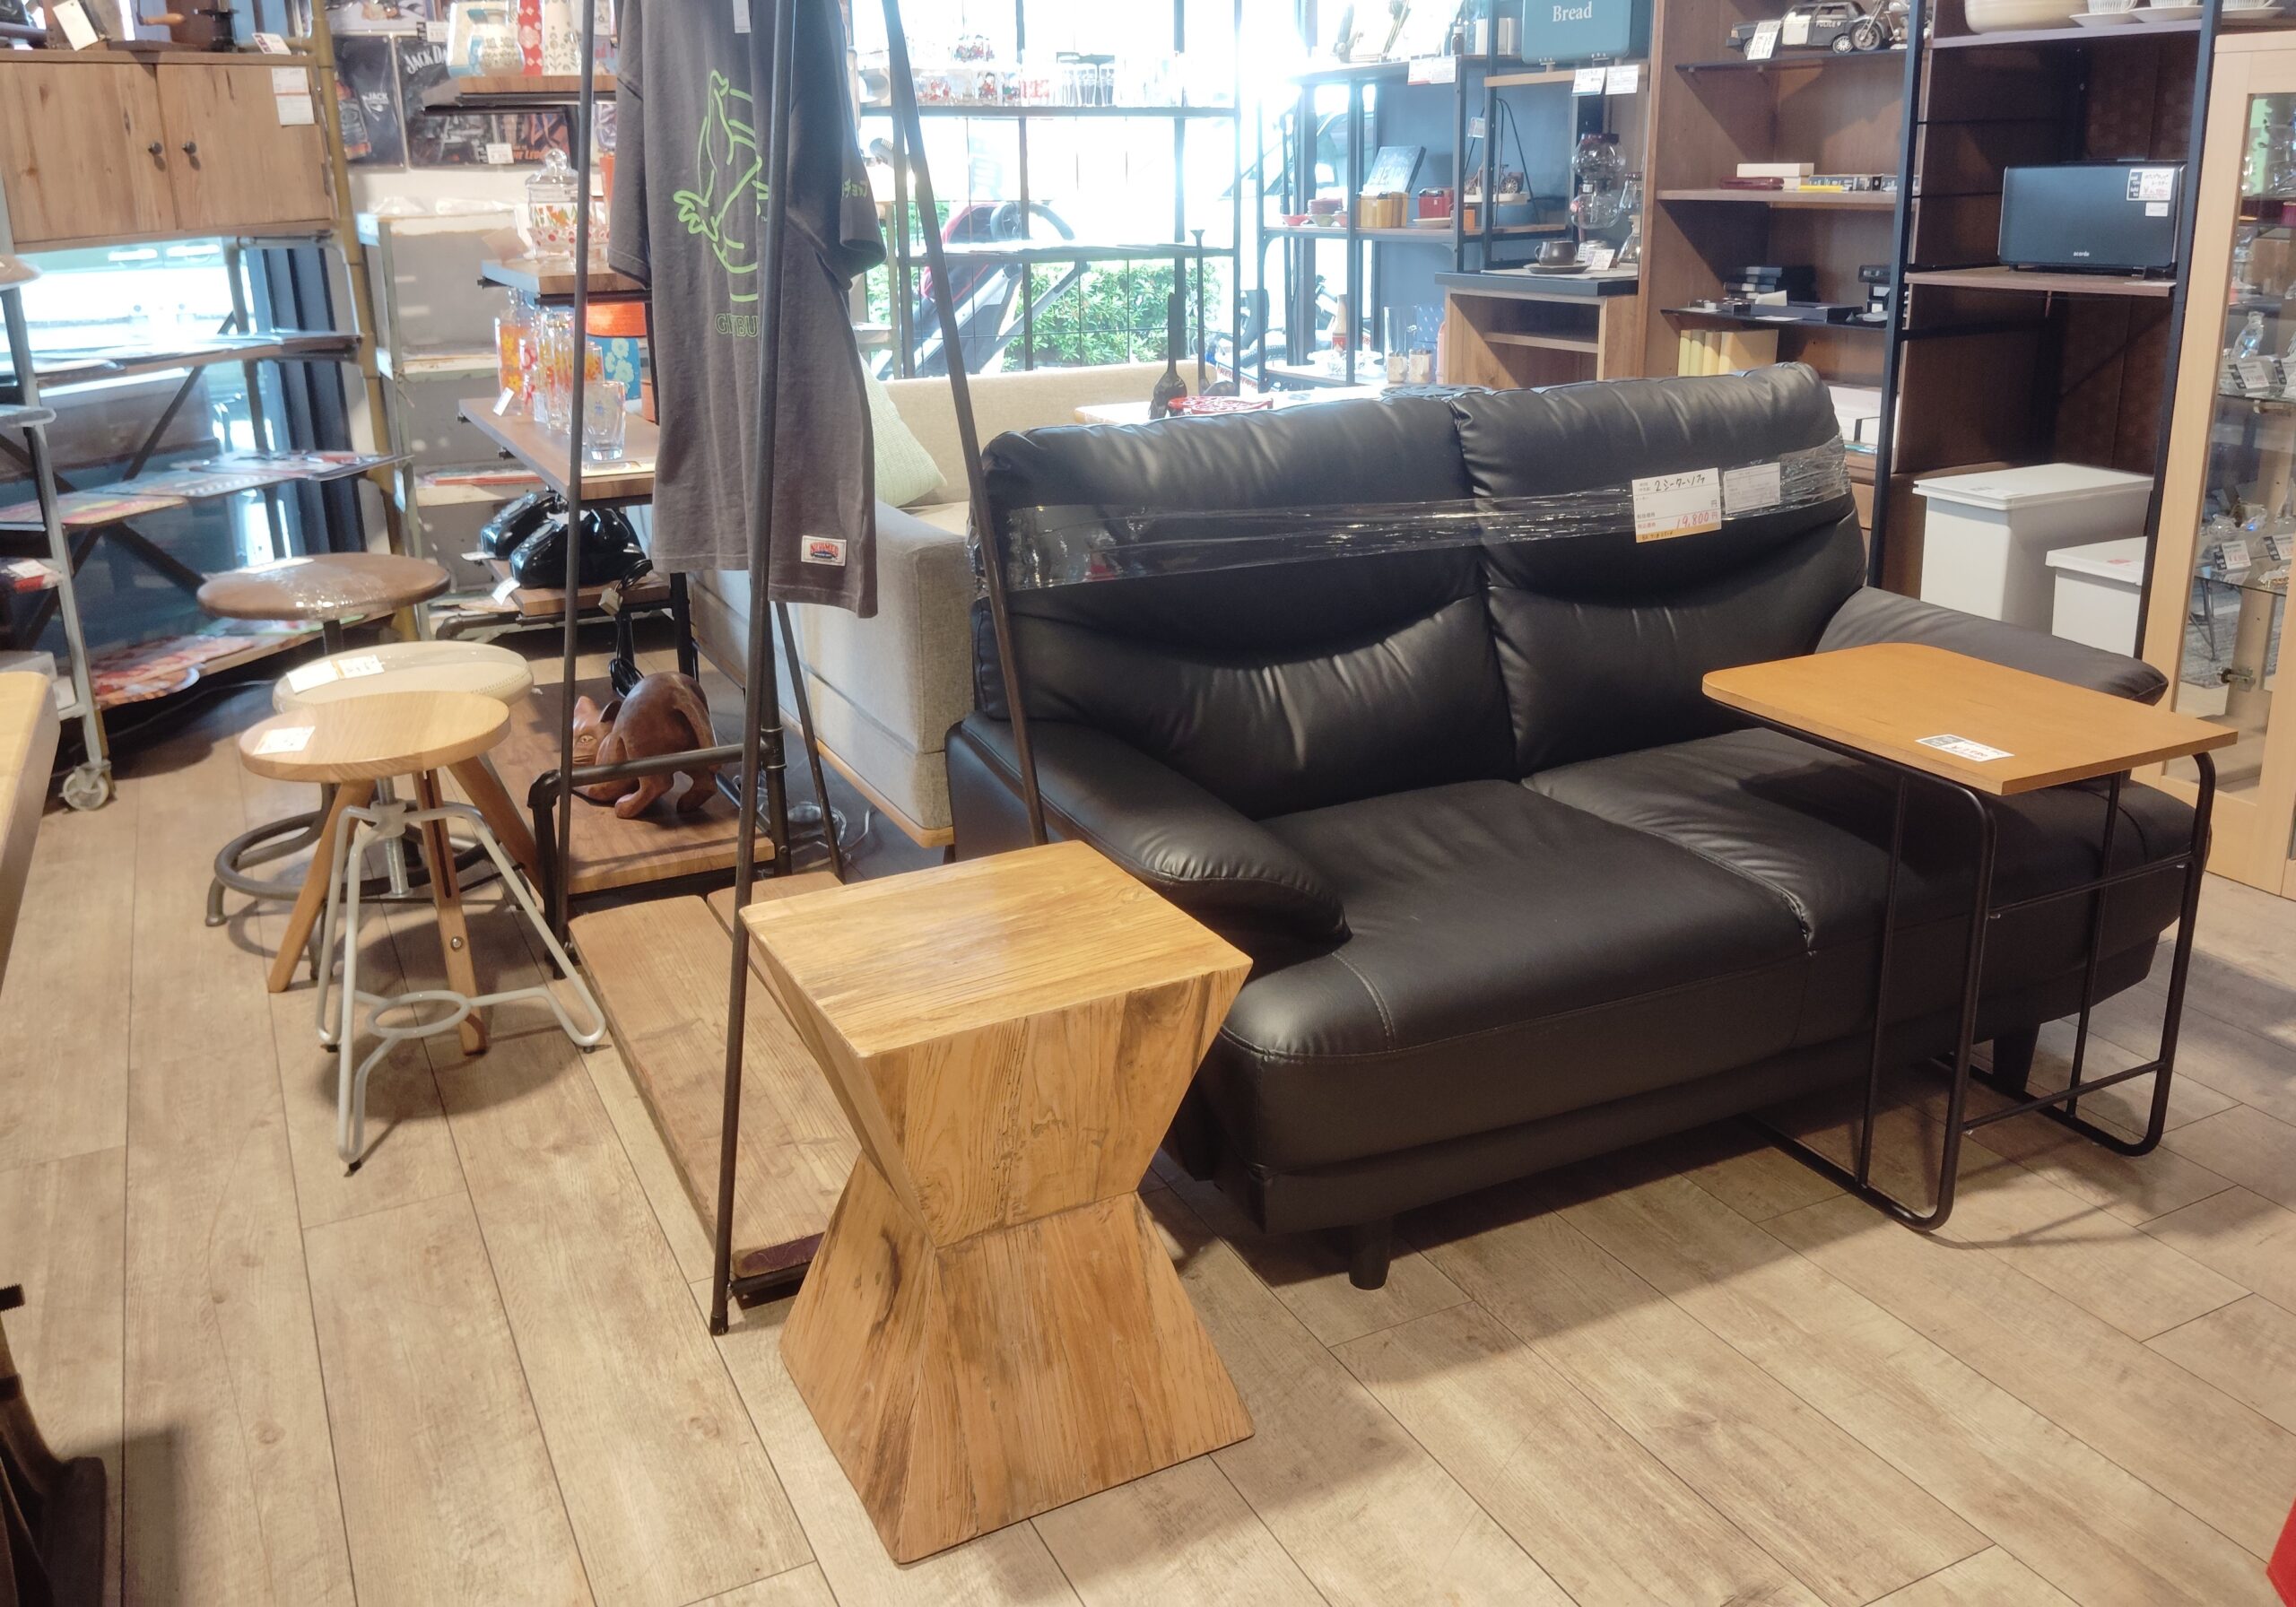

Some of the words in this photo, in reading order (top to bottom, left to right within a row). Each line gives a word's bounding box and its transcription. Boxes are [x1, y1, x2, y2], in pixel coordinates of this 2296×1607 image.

[1552, 1, 1593, 22] Bread
[404, 49, 434, 74] JACK
[367, 92, 388, 101] JACK
